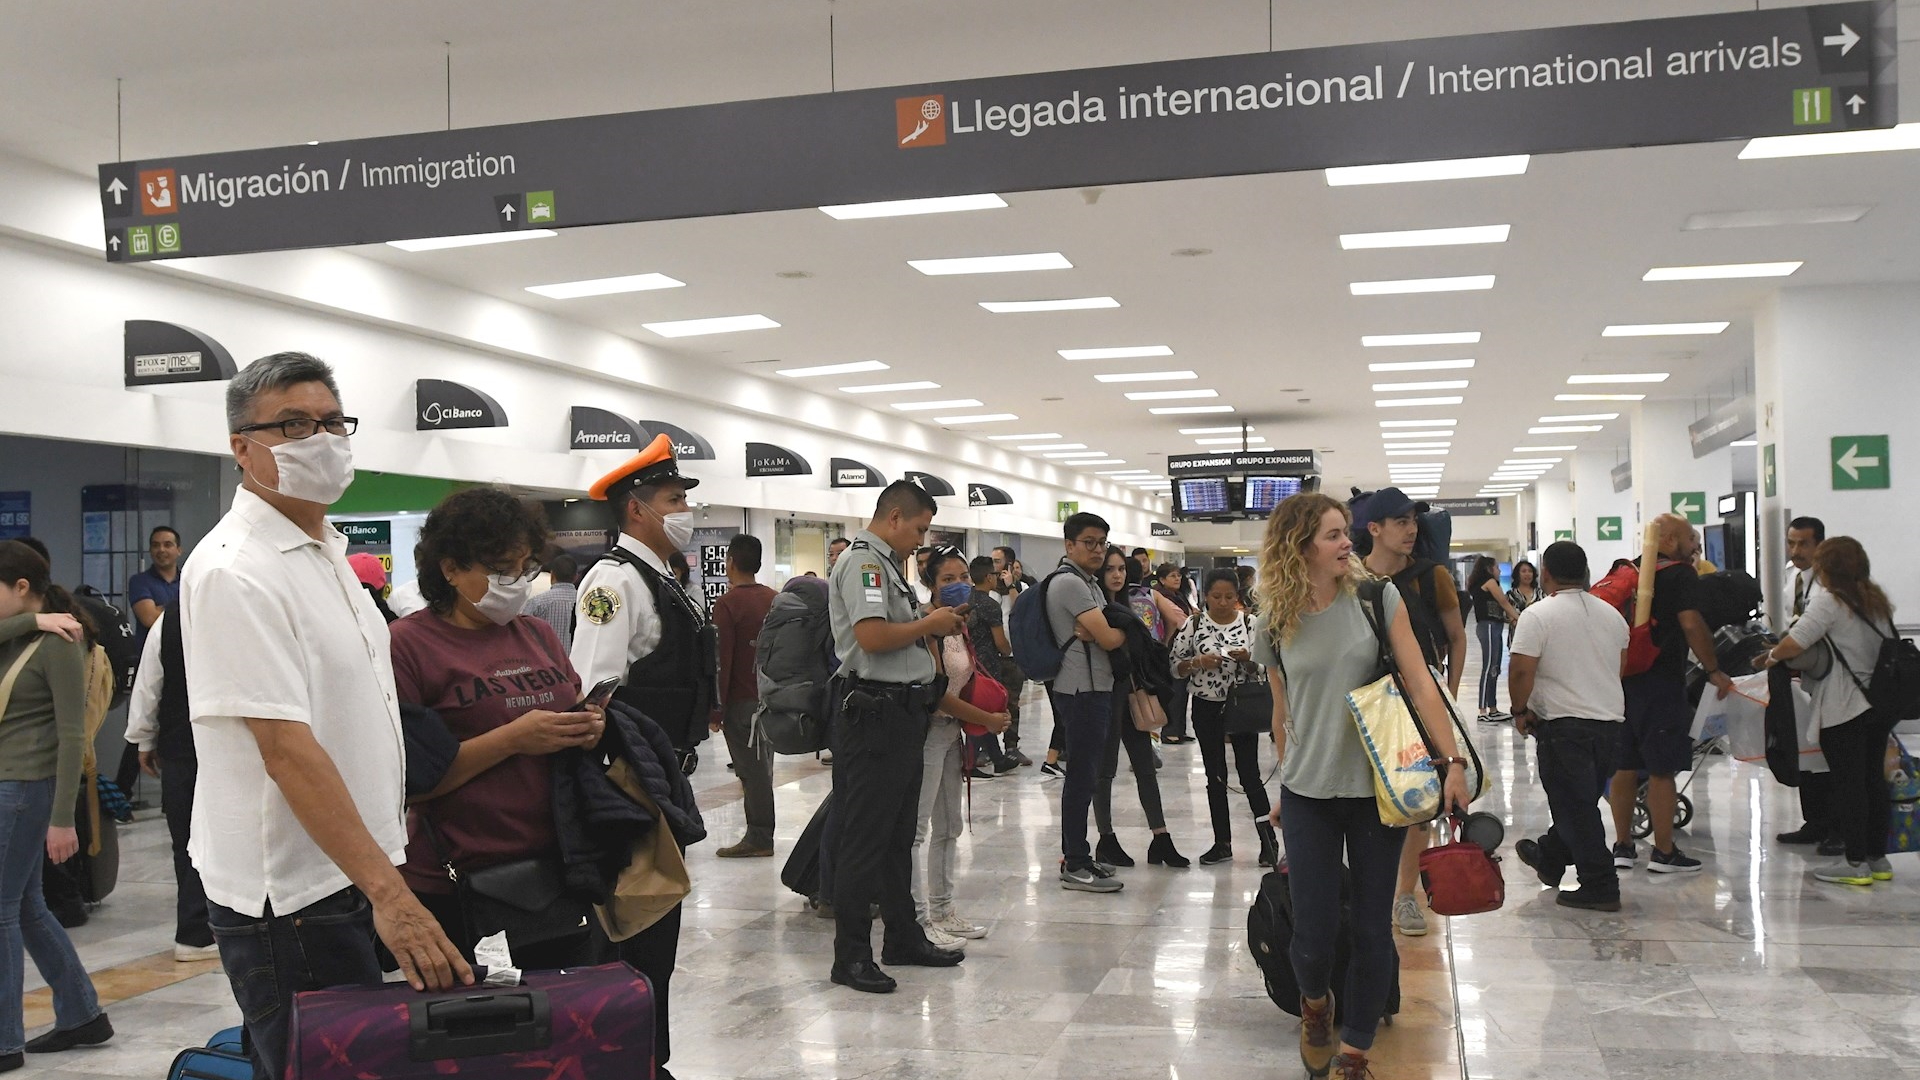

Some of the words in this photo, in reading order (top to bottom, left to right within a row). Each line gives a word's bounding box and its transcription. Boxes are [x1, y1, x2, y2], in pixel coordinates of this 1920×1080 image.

[951, 90, 1106, 137] Llegada
[1118, 65, 1383, 120] internacional
[1396, 61, 1415, 98] /
[1428, 47, 1653, 96] International
[1666, 36, 1802, 76] arrivals
[180, 162, 330, 208] Migración
[338, 158, 351, 191] /
[361, 151, 516, 189] Immigration
[143, 358, 159, 367] FOX
[574, 430, 631, 444] America
[673, 442, 697, 455] rica
[1169, 460, 1192, 469] GRUPO
[1236, 456, 1264, 465] GRUPO
[840, 473, 865, 481] Alamo
[1152, 528, 1172, 536] Hertz
[705, 545, 730, 560] 19.0
[494, 666, 532, 678] Authentic
[454, 676, 507, 708] LAS
[506, 666, 570, 692] VEGA
